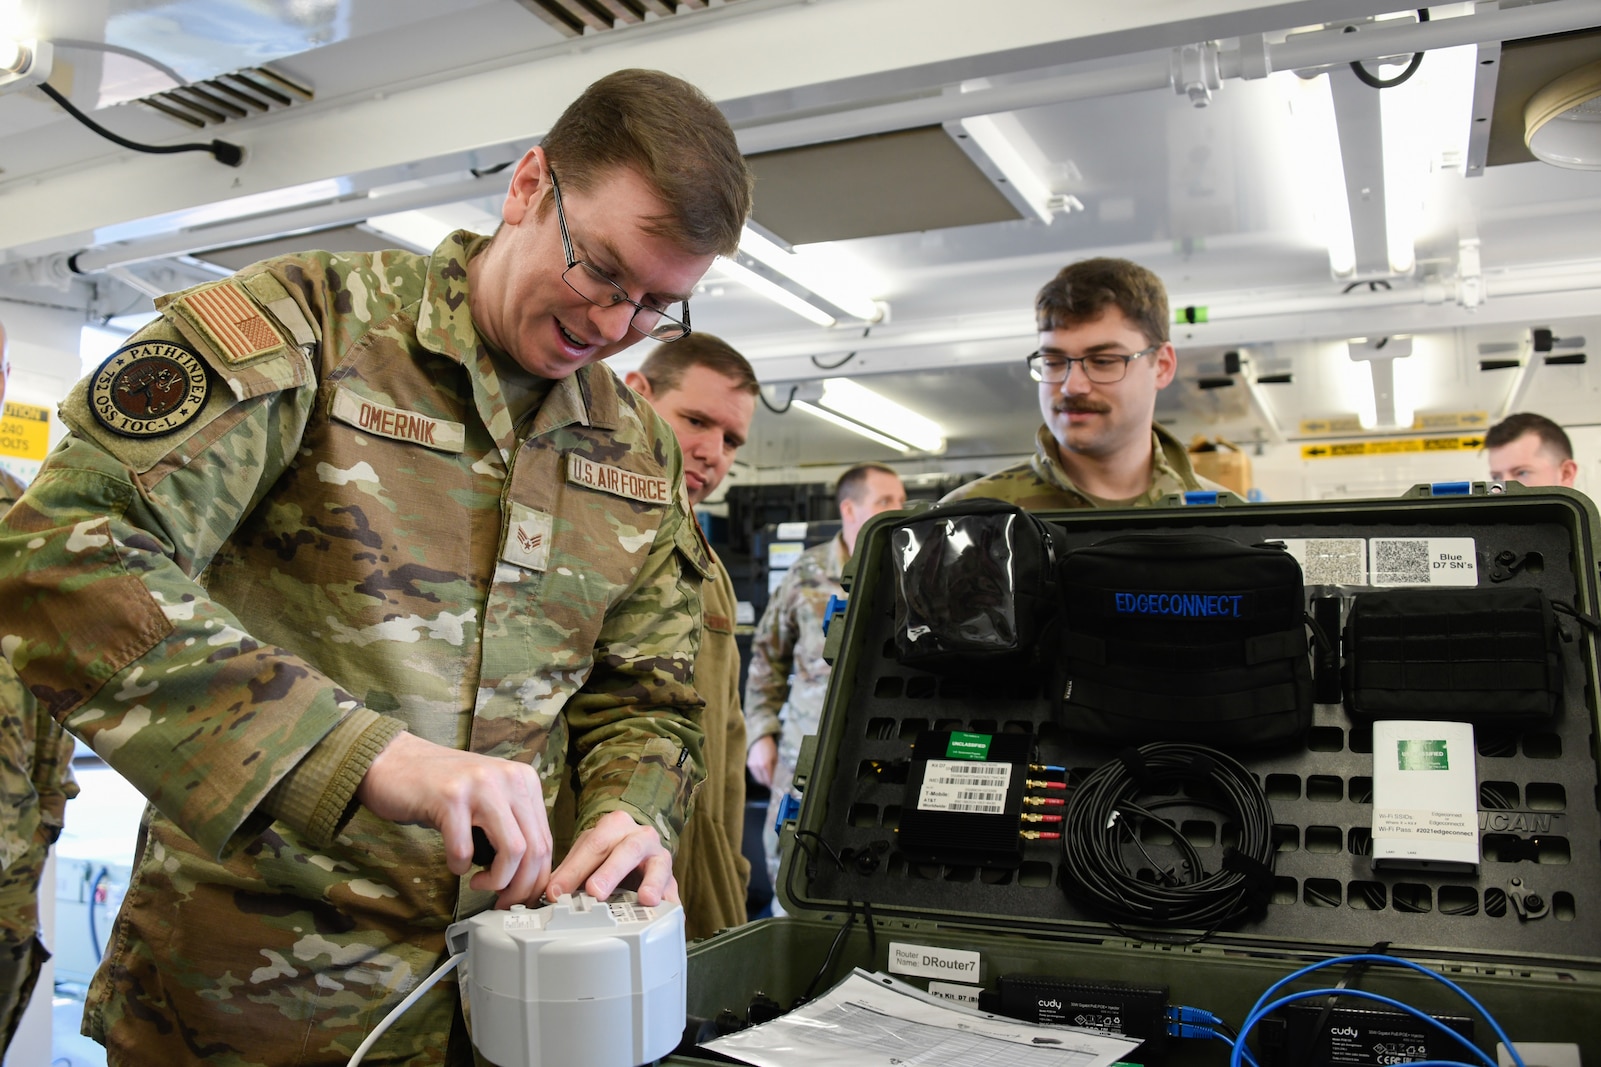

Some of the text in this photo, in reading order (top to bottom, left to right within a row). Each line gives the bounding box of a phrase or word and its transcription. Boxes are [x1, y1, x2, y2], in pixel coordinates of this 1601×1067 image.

[129, 345, 205, 405] PATHFINDER
[96, 370, 177, 432] 752 OSS TOC-L
[358, 402, 437, 445] OMERNIK
[0, 436, 29, 452] OLTS
[573, 457, 667, 501] U.S. AIR FORCE
[1439, 553, 1463, 561] Blue
[1432, 561, 1473, 569] D7 SN's
[1115, 592, 1243, 618] EDGECONNECT
[951, 741, 987, 749] UNCLASSIFIED
[1416, 828, 1474, 837] #2021edgeconnect
[895, 949, 919, 959] Router
[896, 958, 920, 967] Name:
[922, 955, 976, 971] DRouter7
[1038, 998, 1062, 1010] cudy
[1330, 1026, 1358, 1038] cudy
